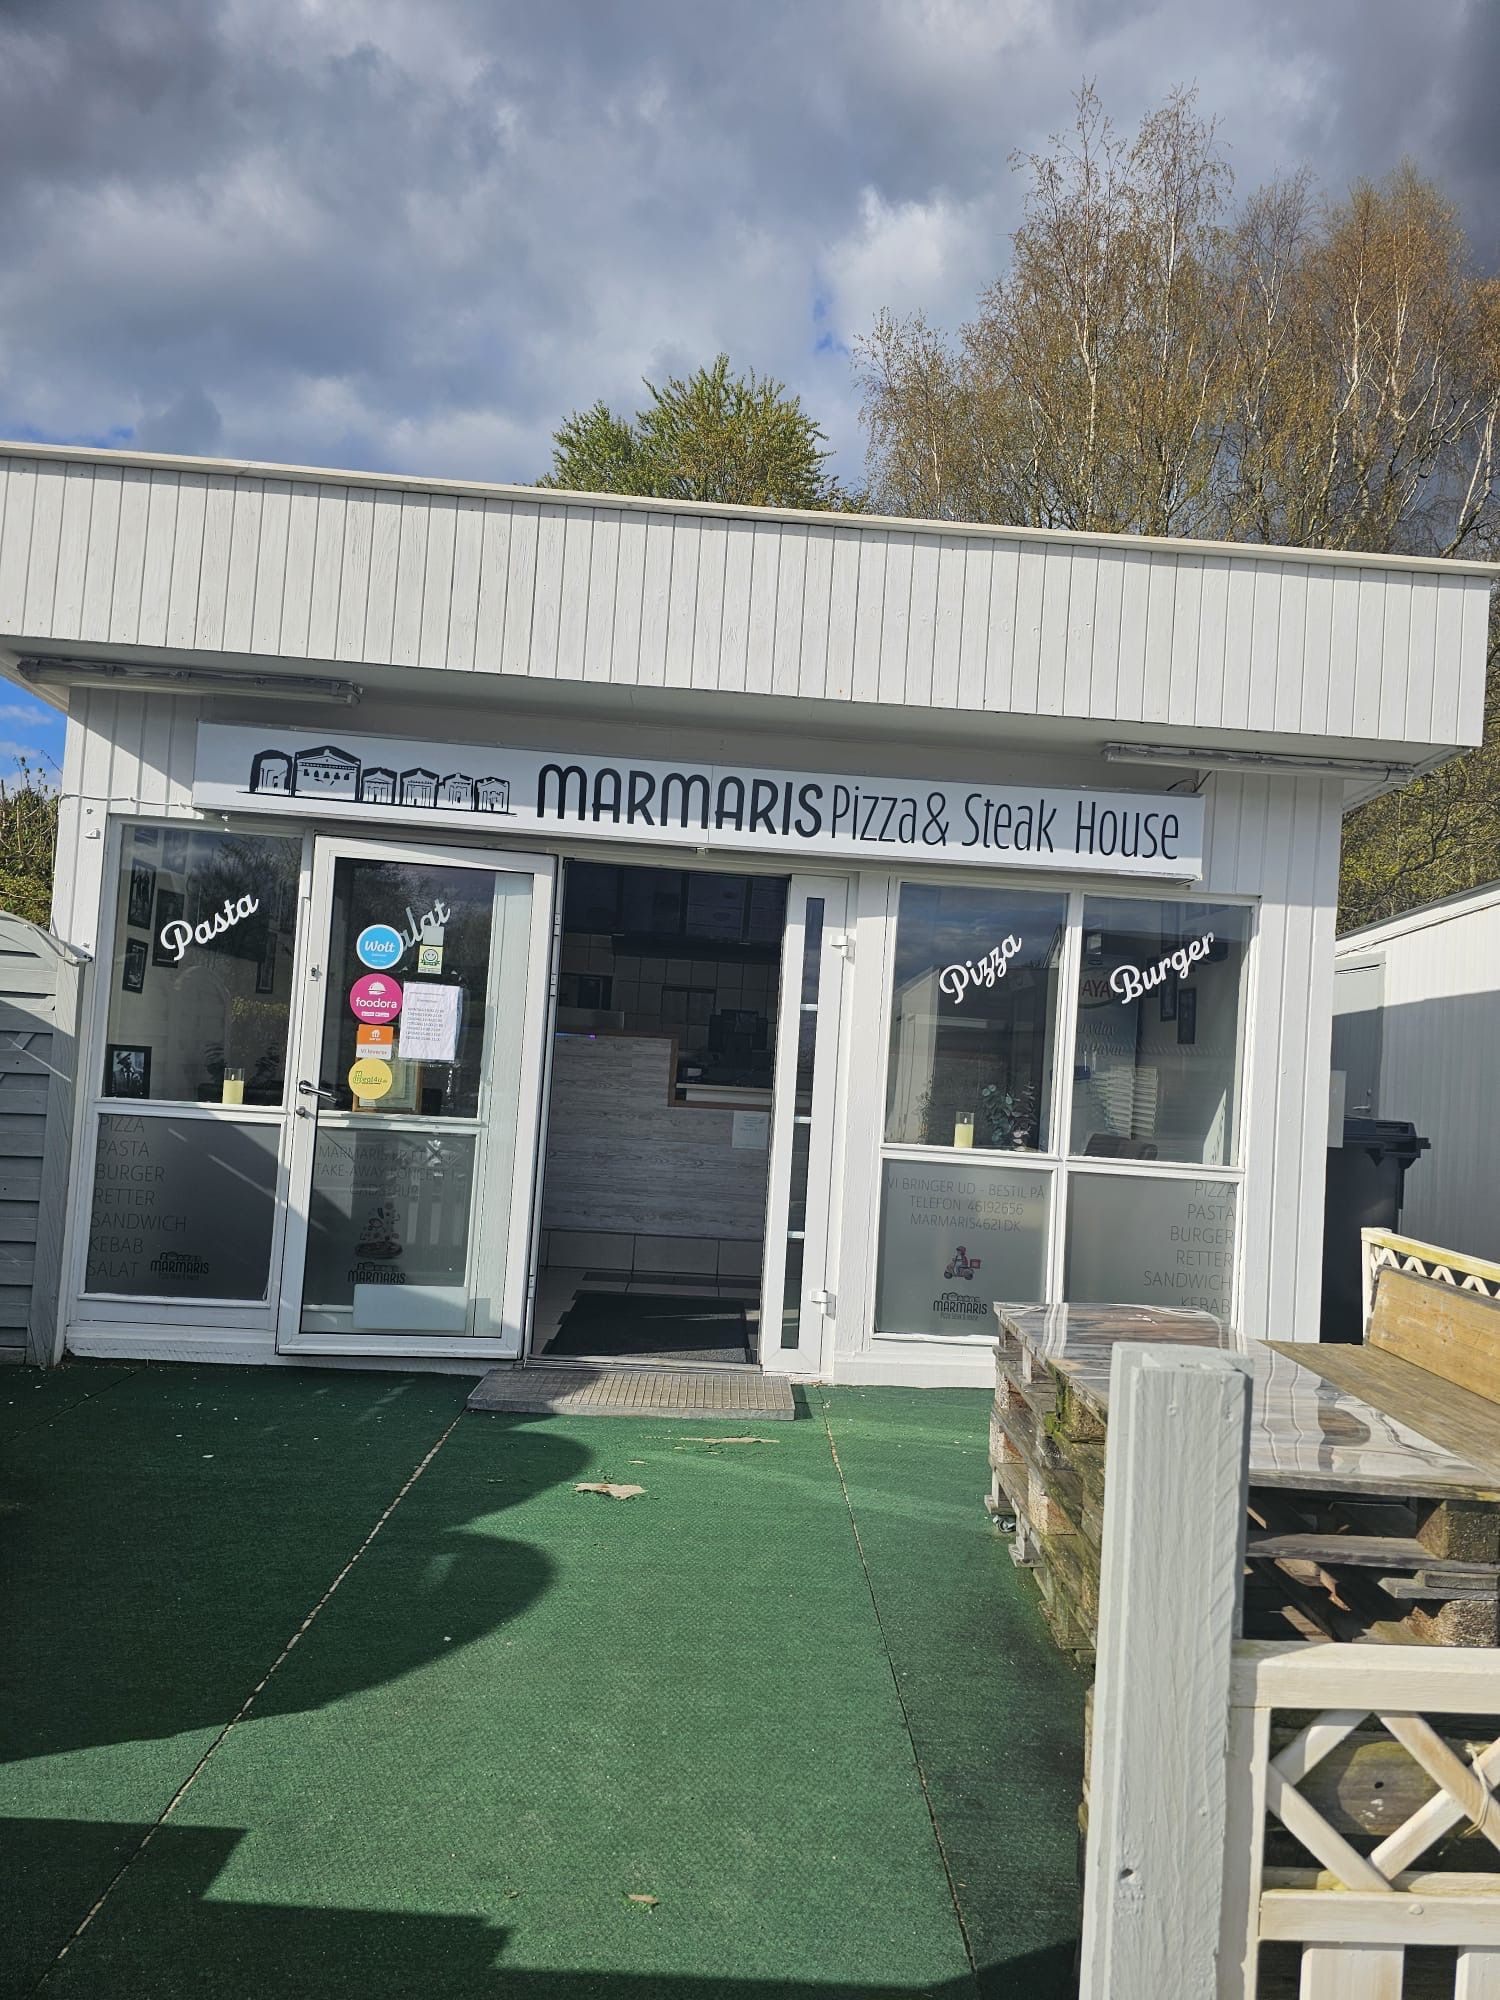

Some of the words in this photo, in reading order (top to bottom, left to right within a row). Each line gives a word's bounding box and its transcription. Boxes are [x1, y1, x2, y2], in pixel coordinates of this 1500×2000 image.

[537, 763, 823, 838] MARMARIS
[961, 793, 1057, 853] Steak
[1075, 800, 1179, 860] House
[160, 894, 259, 961] Pasta
[401, 899, 451, 952] alat
[365, 940, 395, 953] Wolt
[939, 934, 1022, 1004] Pizza
[1109, 931, 1214, 1004] Burger
[356, 997, 398, 1009] foodora
[100, 1116, 145, 1133] PIZZA
[98, 1139, 150, 1157] PASTA
[96, 1163, 165, 1182] BURGER
[94, 1187, 155, 1206] RETTER
[902, 1178, 954, 1193] BRINGER
[958, 1182, 976, 1195] UD
[988, 1184, 1028, 1198] BESTIL
[1030, 1185, 1045, 1200] PÅ
[1194, 1181, 1236, 1198] PIZZA
[909, 1195, 961, 1211] TELEFON
[967, 1200, 1024, 1216] 46192656
[1187, 1203, 1235, 1220] PASTA
[91, 1212, 187, 1232] SANDWICH
[1170, 1226, 1234, 1244] BURGER
[90, 1235, 143, 1254] KEBAB
[150, 1260, 209, 1274] MARMARIS
[1176, 1249, 1233, 1267] RETTER
[88, 1260, 139, 1278] SALAT
[347, 1269, 407, 1285] MARMARIS
[1143, 1270, 1232, 1290] SANDWICH
[932, 1300, 988, 1315] MARMARIS
[1181, 1296, 1231, 1314] KEBAB
